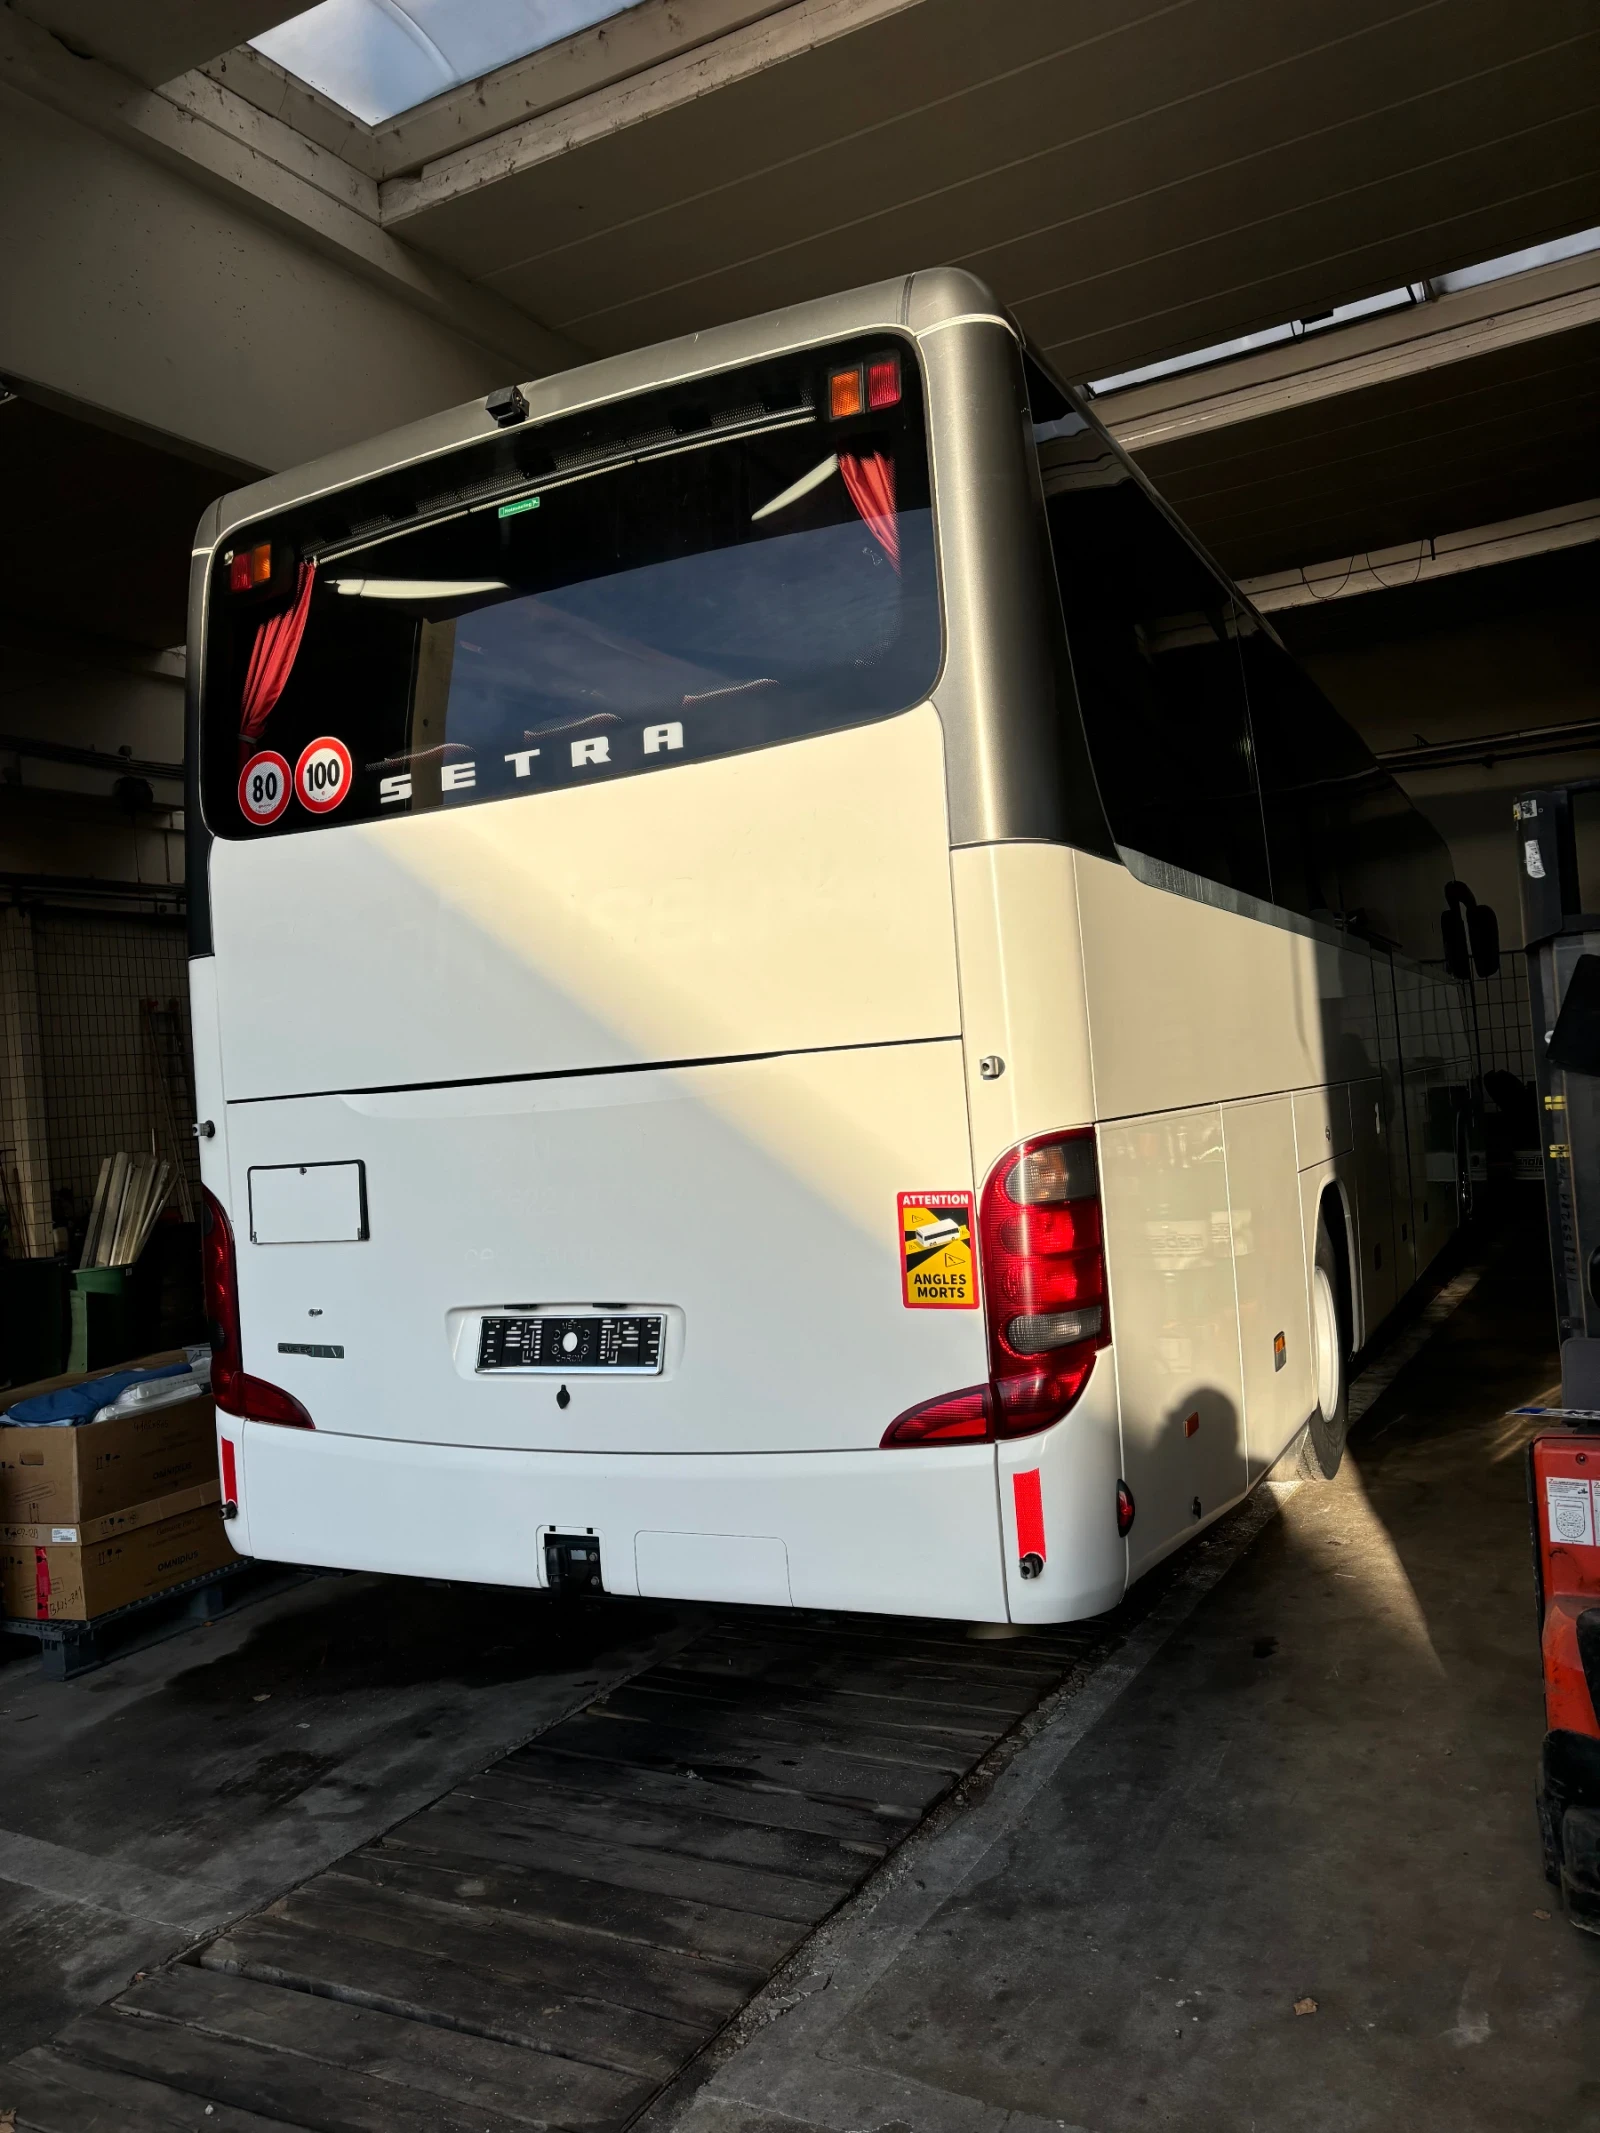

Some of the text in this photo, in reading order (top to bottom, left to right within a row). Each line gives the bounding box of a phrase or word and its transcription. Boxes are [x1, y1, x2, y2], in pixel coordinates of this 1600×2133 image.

[379, 721, 685, 804] SETRA
[307, 758, 340, 791] 100
[253, 772, 277, 803] 80
[903, 1194, 969, 1205] ATTENTION
[914, 1273, 967, 1285] ANGLES
[917, 1287, 965, 1298] MORTS
